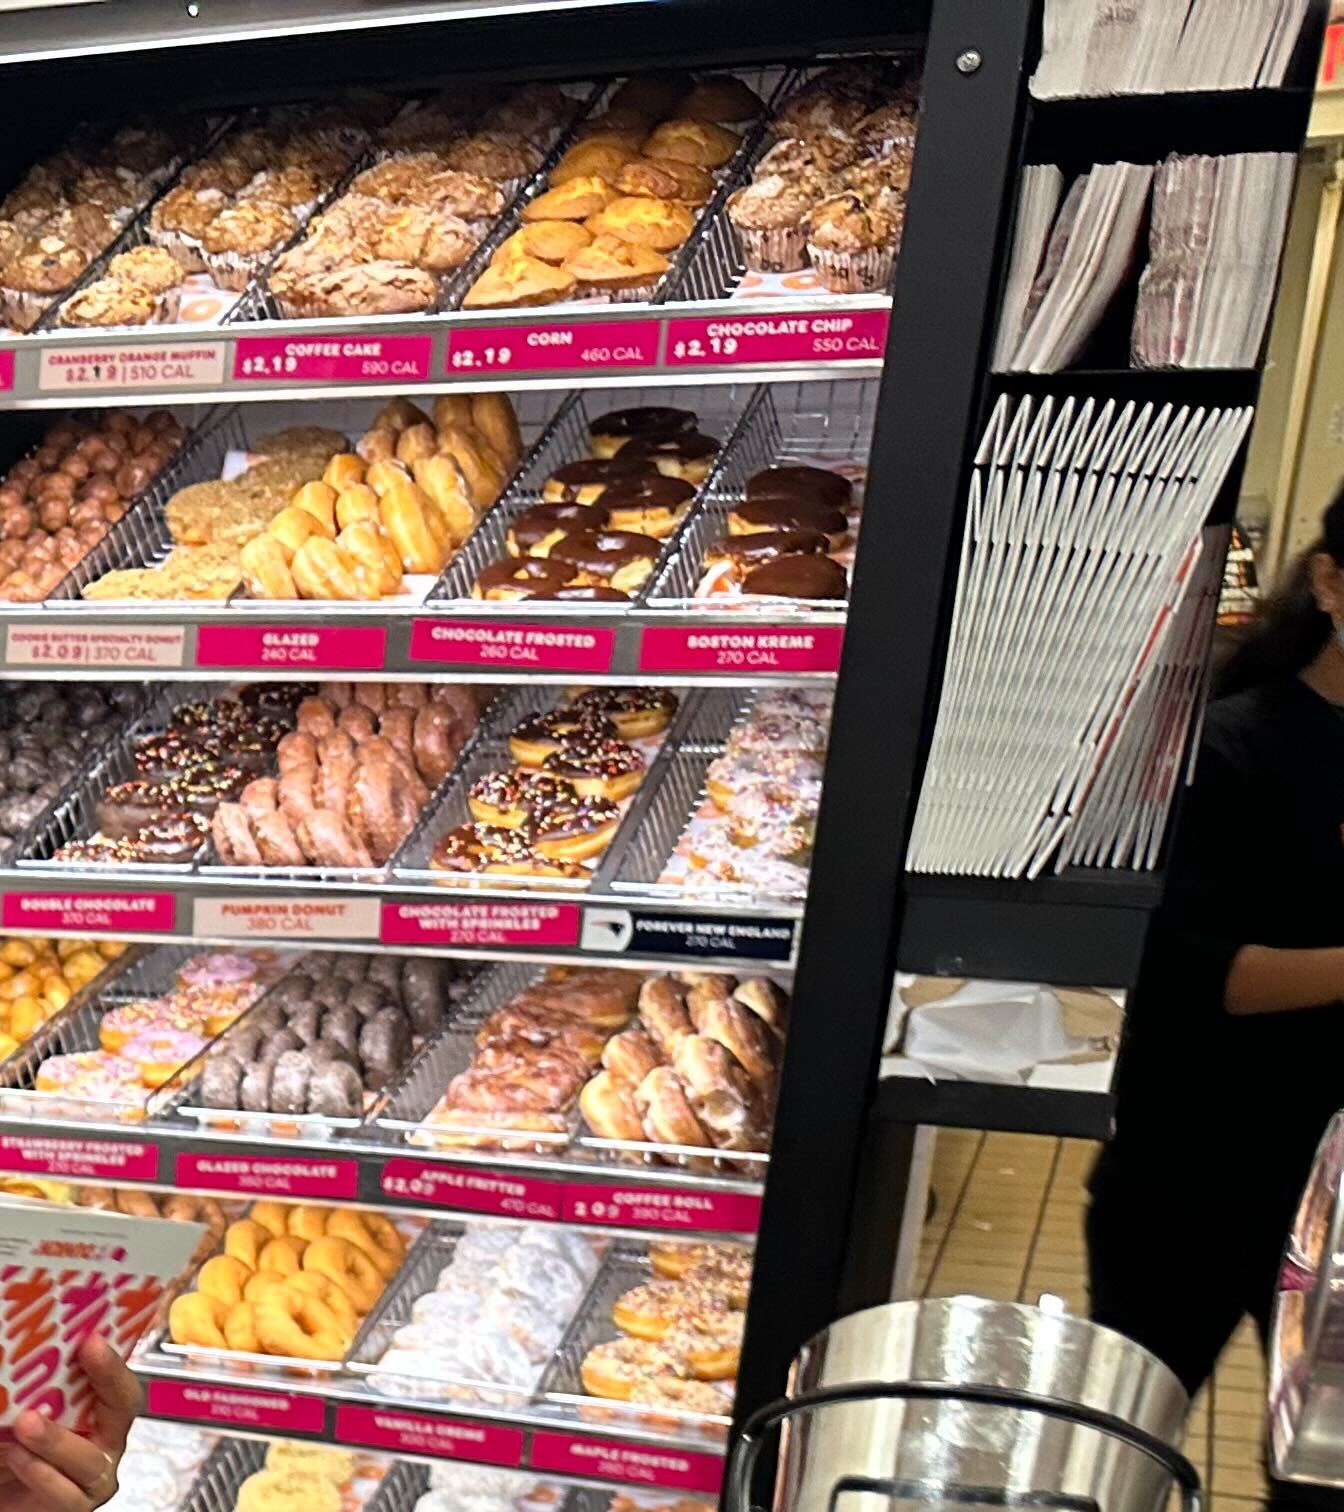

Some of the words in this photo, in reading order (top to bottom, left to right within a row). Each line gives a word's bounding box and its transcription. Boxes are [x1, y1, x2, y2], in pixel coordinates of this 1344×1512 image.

[707, 321, 806, 337] CHOCOLATE
[812, 318, 852, 333] CHIP
[527, 330, 573, 347] CORN
[286, 342, 339, 357] COFFEE
[343, 342, 381, 356] CAKE
[674, 337, 737, 358] $2.19
[812, 338, 842, 353] 550
[846, 337, 879, 352] CAL
[48, 351, 114, 365] CRANBERRY
[118, 350, 167, 363] ORANGE
[171, 348, 216, 361] MUFFIN
[242, 354, 297, 374] $2.19
[389, 361, 419, 374] CAL
[452, 347, 511, 368] $2.19
[581, 348, 609, 362] 460
[612, 347, 644, 361] CAL
[161, 363, 194, 378] CAL
[262, 633, 319, 646] GLAZED
[431, 627, 522, 643] CHOCOLATE
[525, 631, 596, 648] FROSTED
[688, 635, 754, 649] BOSTON
[757, 635, 813, 649] KREME
[124, 647, 157, 662] CAL
[288, 648, 316, 662] CAL
[510, 647, 539, 660] CAL
[748, 650, 778, 664] CAL
[21, 898, 70, 911] DOUBLE
[74, 897, 156, 912] CHOCOLATE
[222, 903, 288, 917] PUMPKIN
[291, 904, 345, 917] DONUT
[399, 904, 487, 919] CHOCOLATE
[490, 906, 559, 919] FROSTED
[88, 912, 111, 925] CAL
[280, 917, 313, 930] CAL
[420, 918, 459, 930] WITH
[462, 917, 540, 930] SPRINKLES
[478, 930, 506, 943] CAL
[637, 920, 695, 934] FOREVER
[698, 924, 725, 935] NEW
[727, 925, 791, 939] ENGLAND
[707, 937, 736, 949] CAL
[197, 1159, 249, 1172] GLAZED
[252, 1162, 337, 1178] CHOCOLATE
[422, 1169, 467, 1186] APPLE
[469, 1175, 526, 1196] FRITTER
[614, 1192, 670, 1207] COFFEE
[673, 1194, 712, 1210] ROLL
[528, 1201, 556, 1217] CAL
[660, 1208, 692, 1224] CAL
